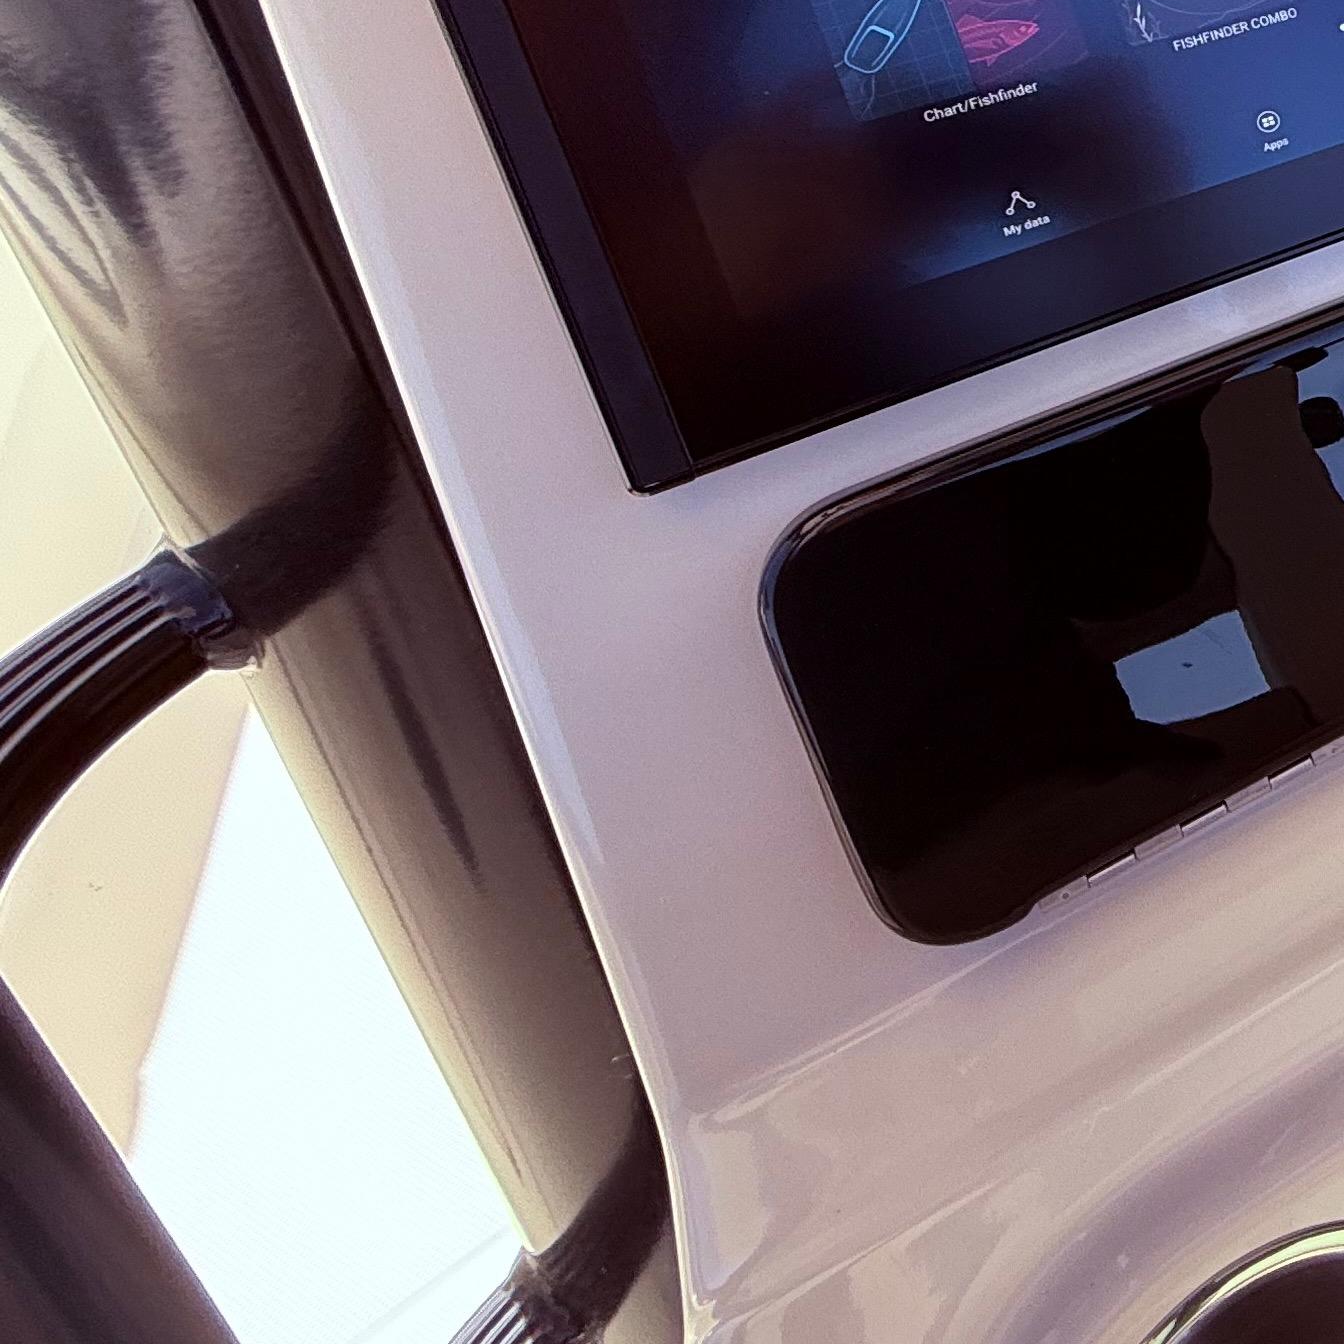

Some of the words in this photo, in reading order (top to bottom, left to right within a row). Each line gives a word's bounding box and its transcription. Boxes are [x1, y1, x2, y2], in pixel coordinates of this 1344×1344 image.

[1172, 21, 1250, 52] FISHFINDER
[1249, 6, 1299, 33] COMBO
[923, 81, 1039, 123] Chart/Fishfinder
[1263, 138, 1289, 152] Apps
[1003, 223, 1022, 237] My
[1023, 214, 1051, 230] data
